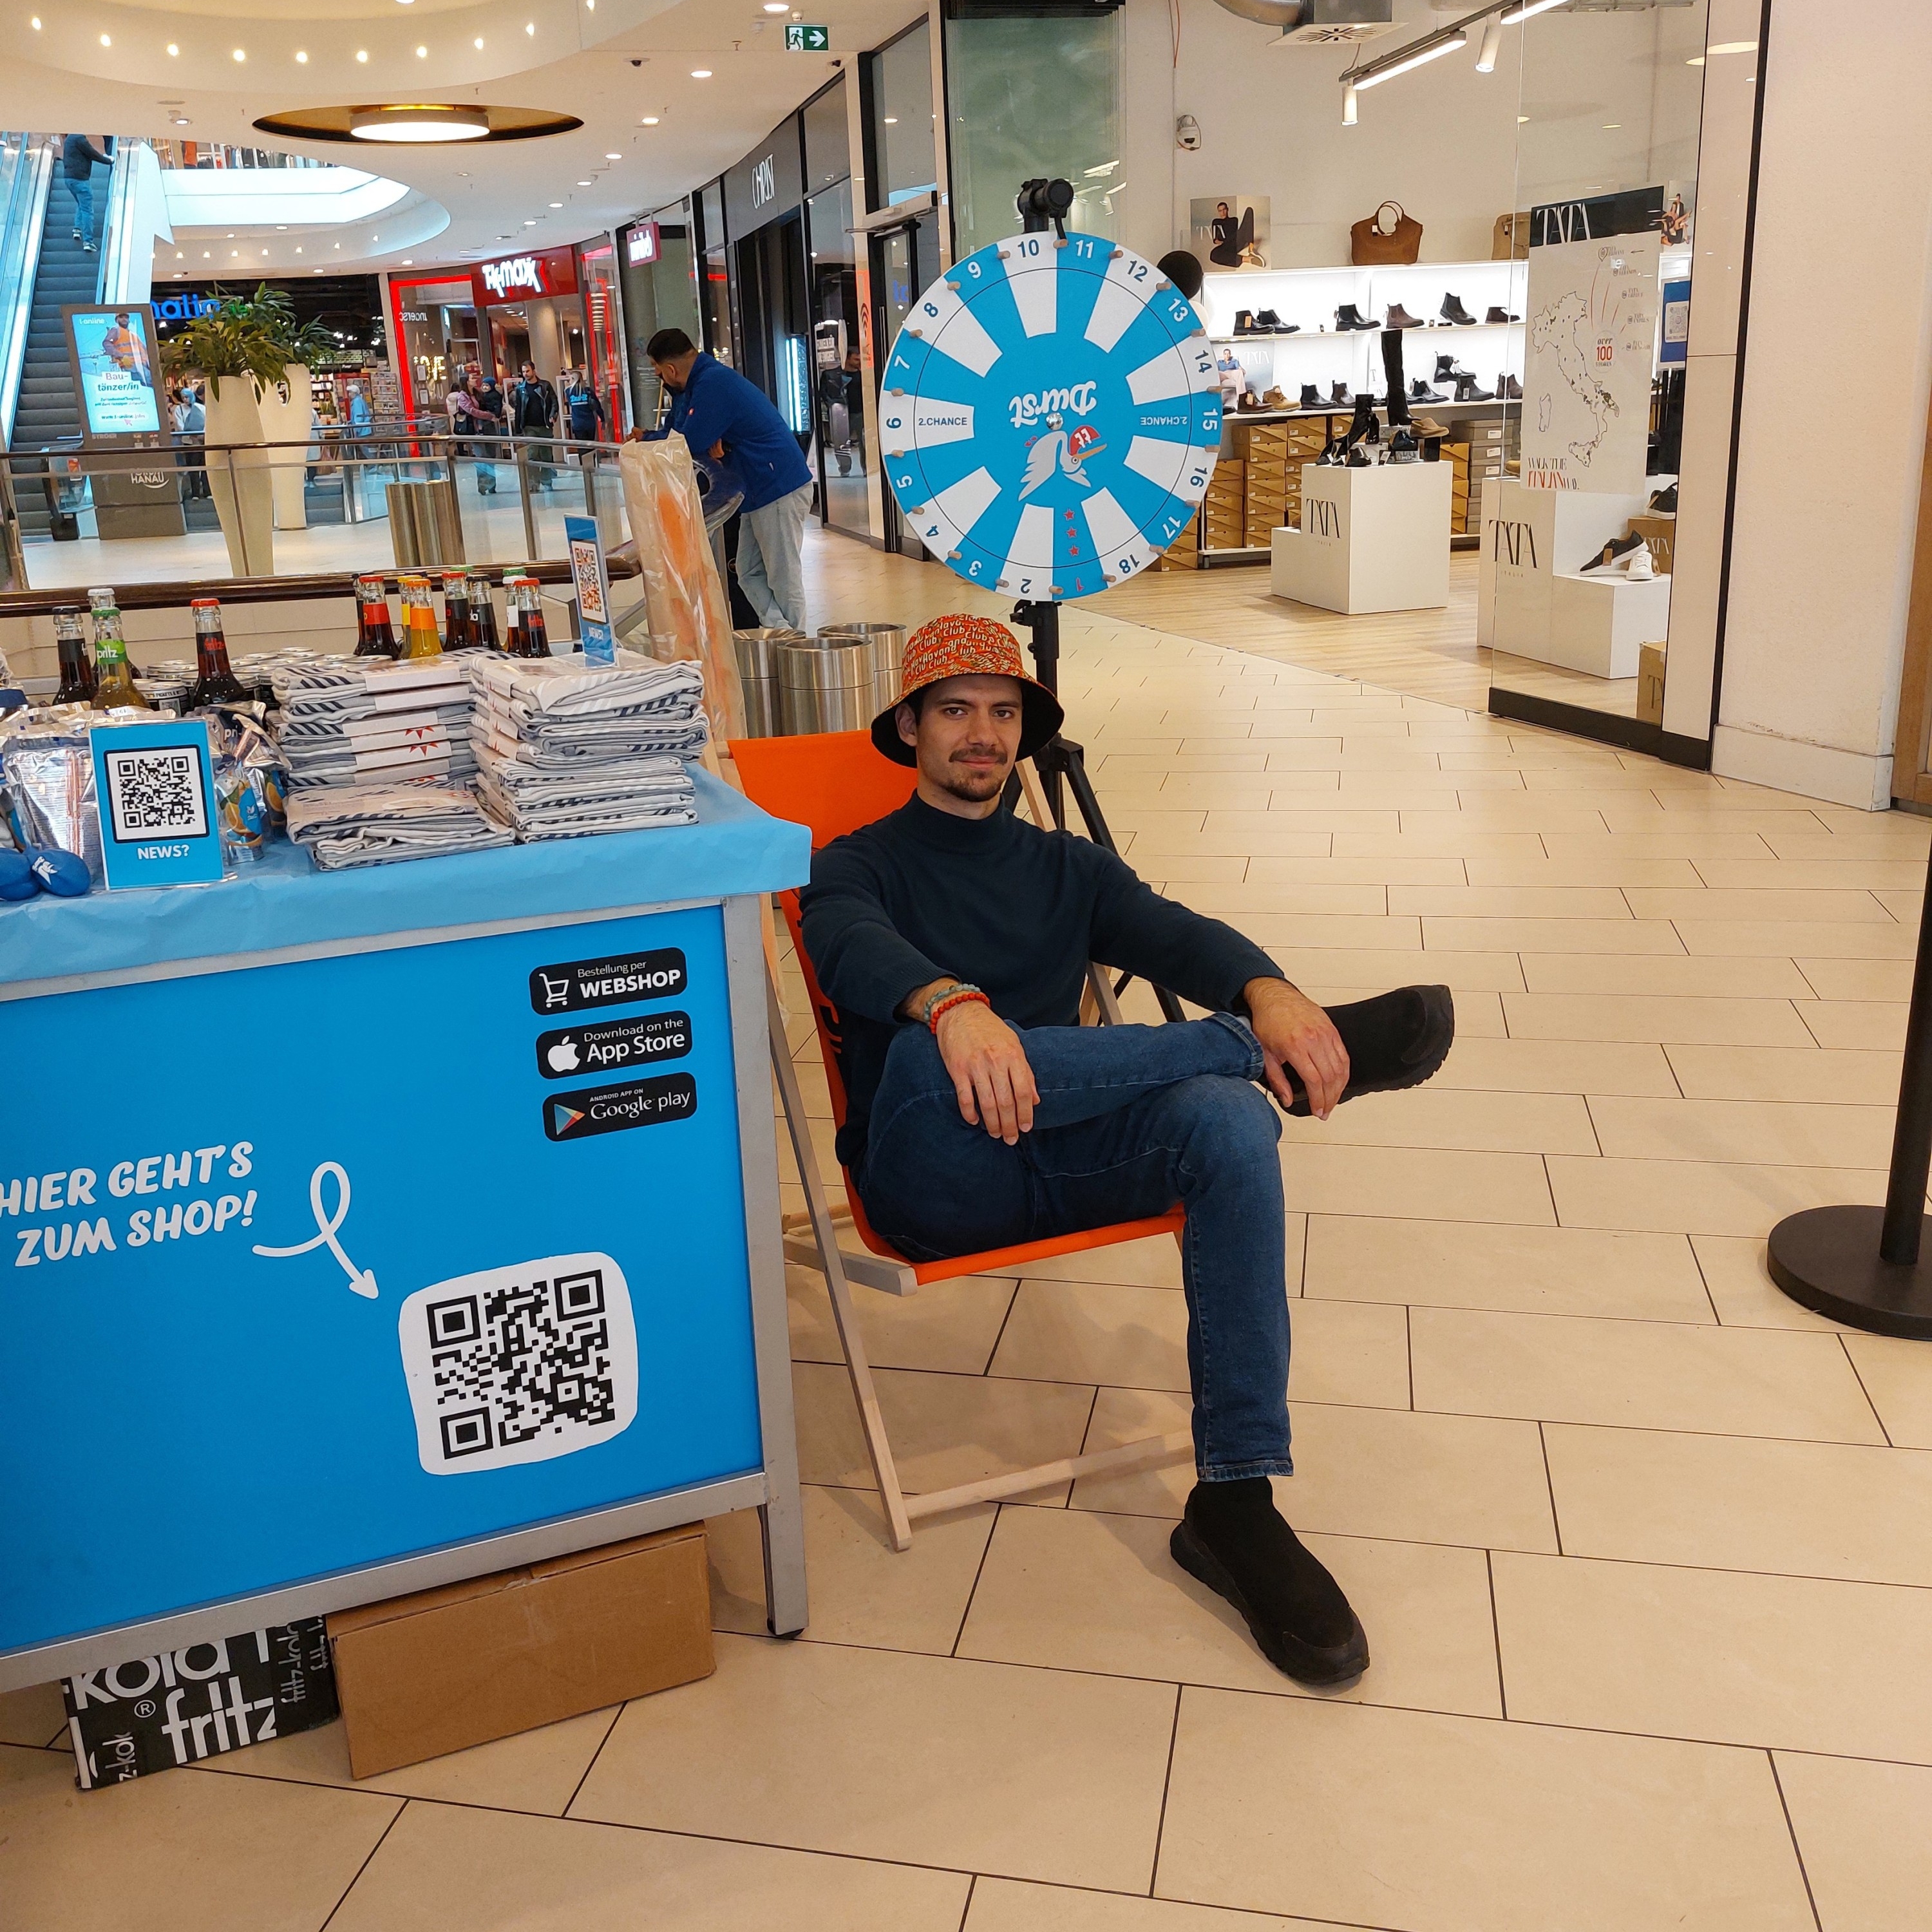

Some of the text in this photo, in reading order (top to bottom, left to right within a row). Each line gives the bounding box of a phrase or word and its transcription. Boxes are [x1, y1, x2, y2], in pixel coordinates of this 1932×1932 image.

[752, 154, 775, 209] CHRIST
[1537, 202, 1591, 245] TATA
[1018, 239, 1039, 258] 10
[1075, 240, 1094, 258] 11
[968, 261, 981, 278] 9
[1127, 260, 1148, 282] 12
[923, 303, 938, 317] 8
[1168, 298, 1189, 322] 13
[894, 355, 910, 370] 7
[1195, 350, 1212, 373] 14
[1596, 346, 1613, 361] 100
[106, 372, 128, 381] Bau-
[98, 382, 138, 391] tänzer/in
[1009, 380, 1097, 428] Durst
[886, 418, 902, 429] 6
[918, 417, 967, 426] 2.CHANCE
[1140, 416, 1188, 425] 2.CHANCE
[1202, 408, 1218, 430] 15
[896, 475, 913, 488] 5
[1190, 467, 1208, 488] 16
[1306, 498, 1341, 538] TATA
[926, 525, 939, 537] 4
[1162, 516, 1182, 539] 17
[1488, 519, 1540, 569] TATA
[969, 561, 982, 576] 3
[1119, 554, 1140, 574] 18
[1020, 578, 1032, 594] 2
[1075, 577, 1084, 592] 1
[943, 627, 965, 636] Club
[965, 632, 987, 641] Club
[137, 844, 190, 860] NEWS?
[578, 961, 647, 978] Bestellung per
[580, 969, 681, 998] WEBSHOP
[584, 1019, 684, 1042] Download on the
[587, 1034, 685, 1065] App Store
[589, 1093, 619, 1103] ANDROID
[591, 1091, 690, 1119] Google play
[0, 1168, 97, 1217] HIER
[14, 1189, 258, 1267] ZUM SHOP!
[162, 1676, 277, 1765] fritz
